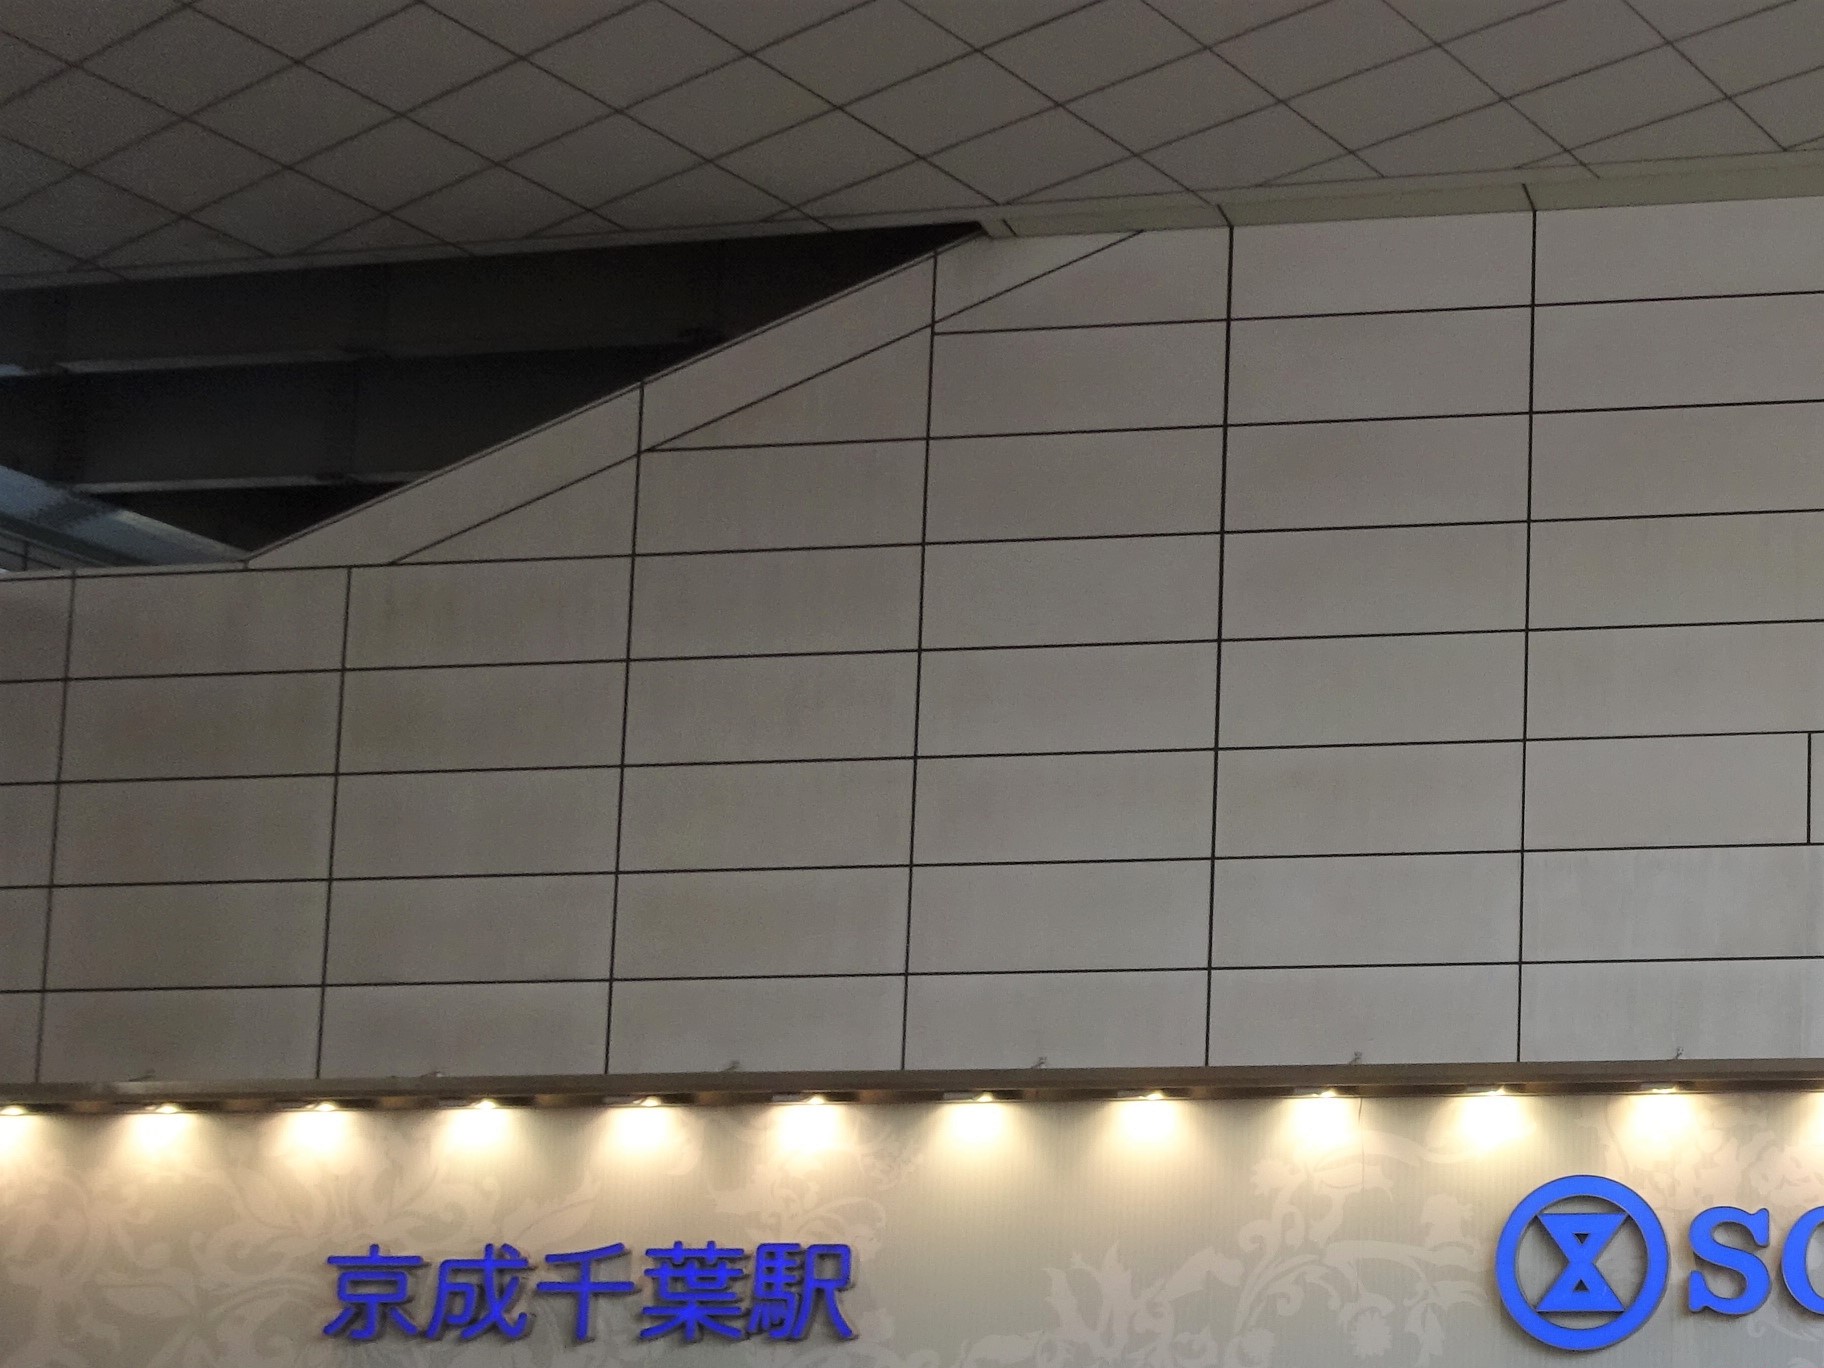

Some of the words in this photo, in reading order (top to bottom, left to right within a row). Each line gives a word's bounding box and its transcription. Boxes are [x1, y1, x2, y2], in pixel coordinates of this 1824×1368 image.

[323, 1240, 857, 1342] 京成千葉駅
